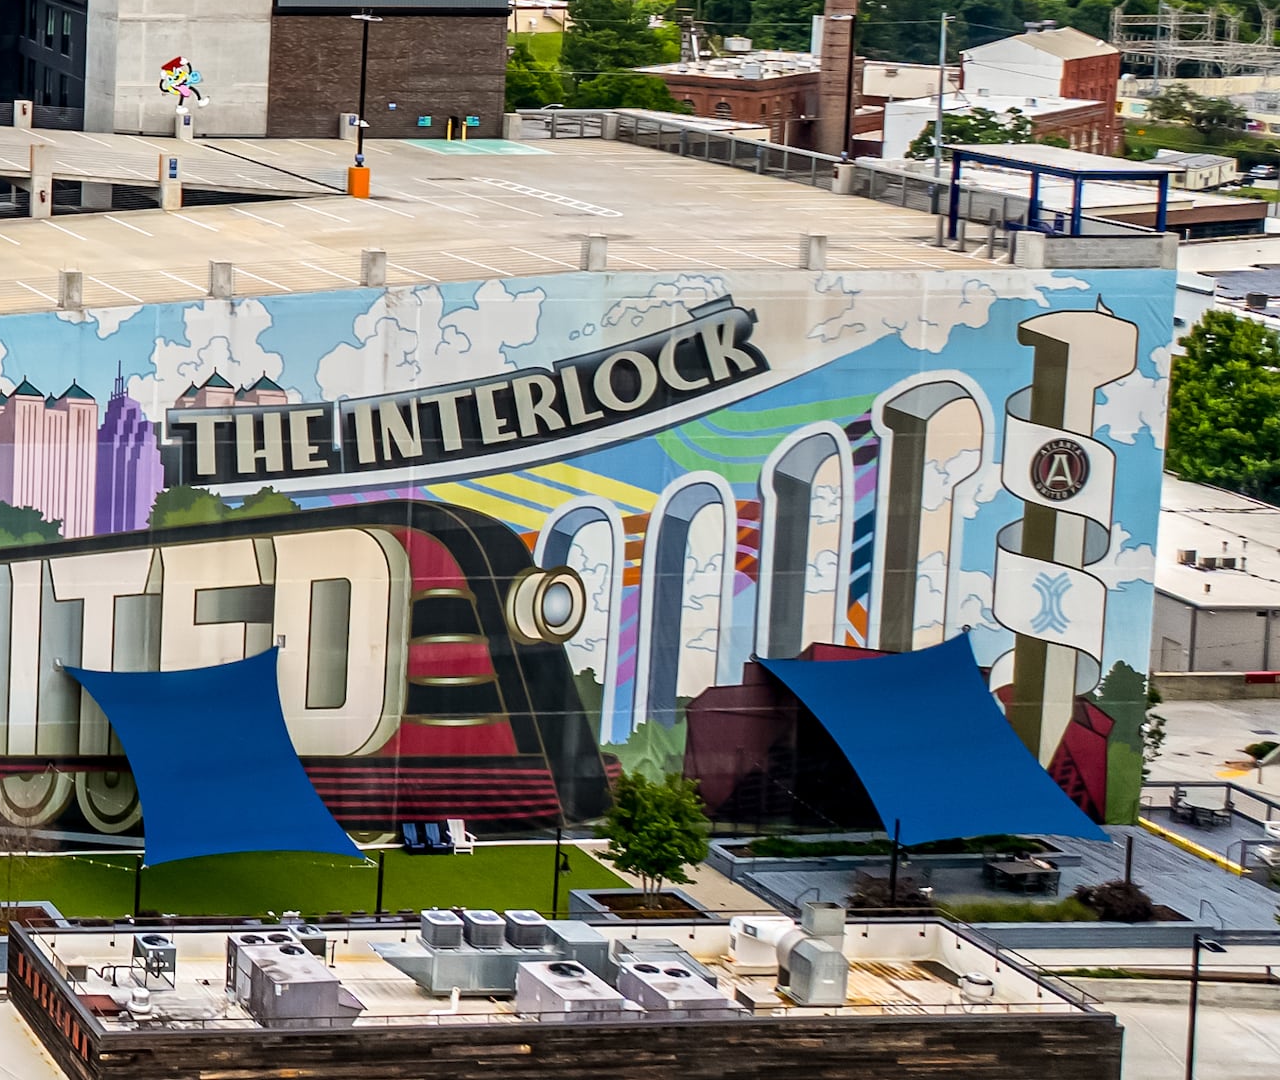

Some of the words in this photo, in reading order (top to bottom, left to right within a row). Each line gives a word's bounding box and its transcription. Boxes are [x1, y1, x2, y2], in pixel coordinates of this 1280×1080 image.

[178, 408, 329, 476] THE
[354, 316, 757, 465] INTERLOCK
[1040, 440, 1083, 457] ATLANTA
[1045, 453, 1074, 487] A
